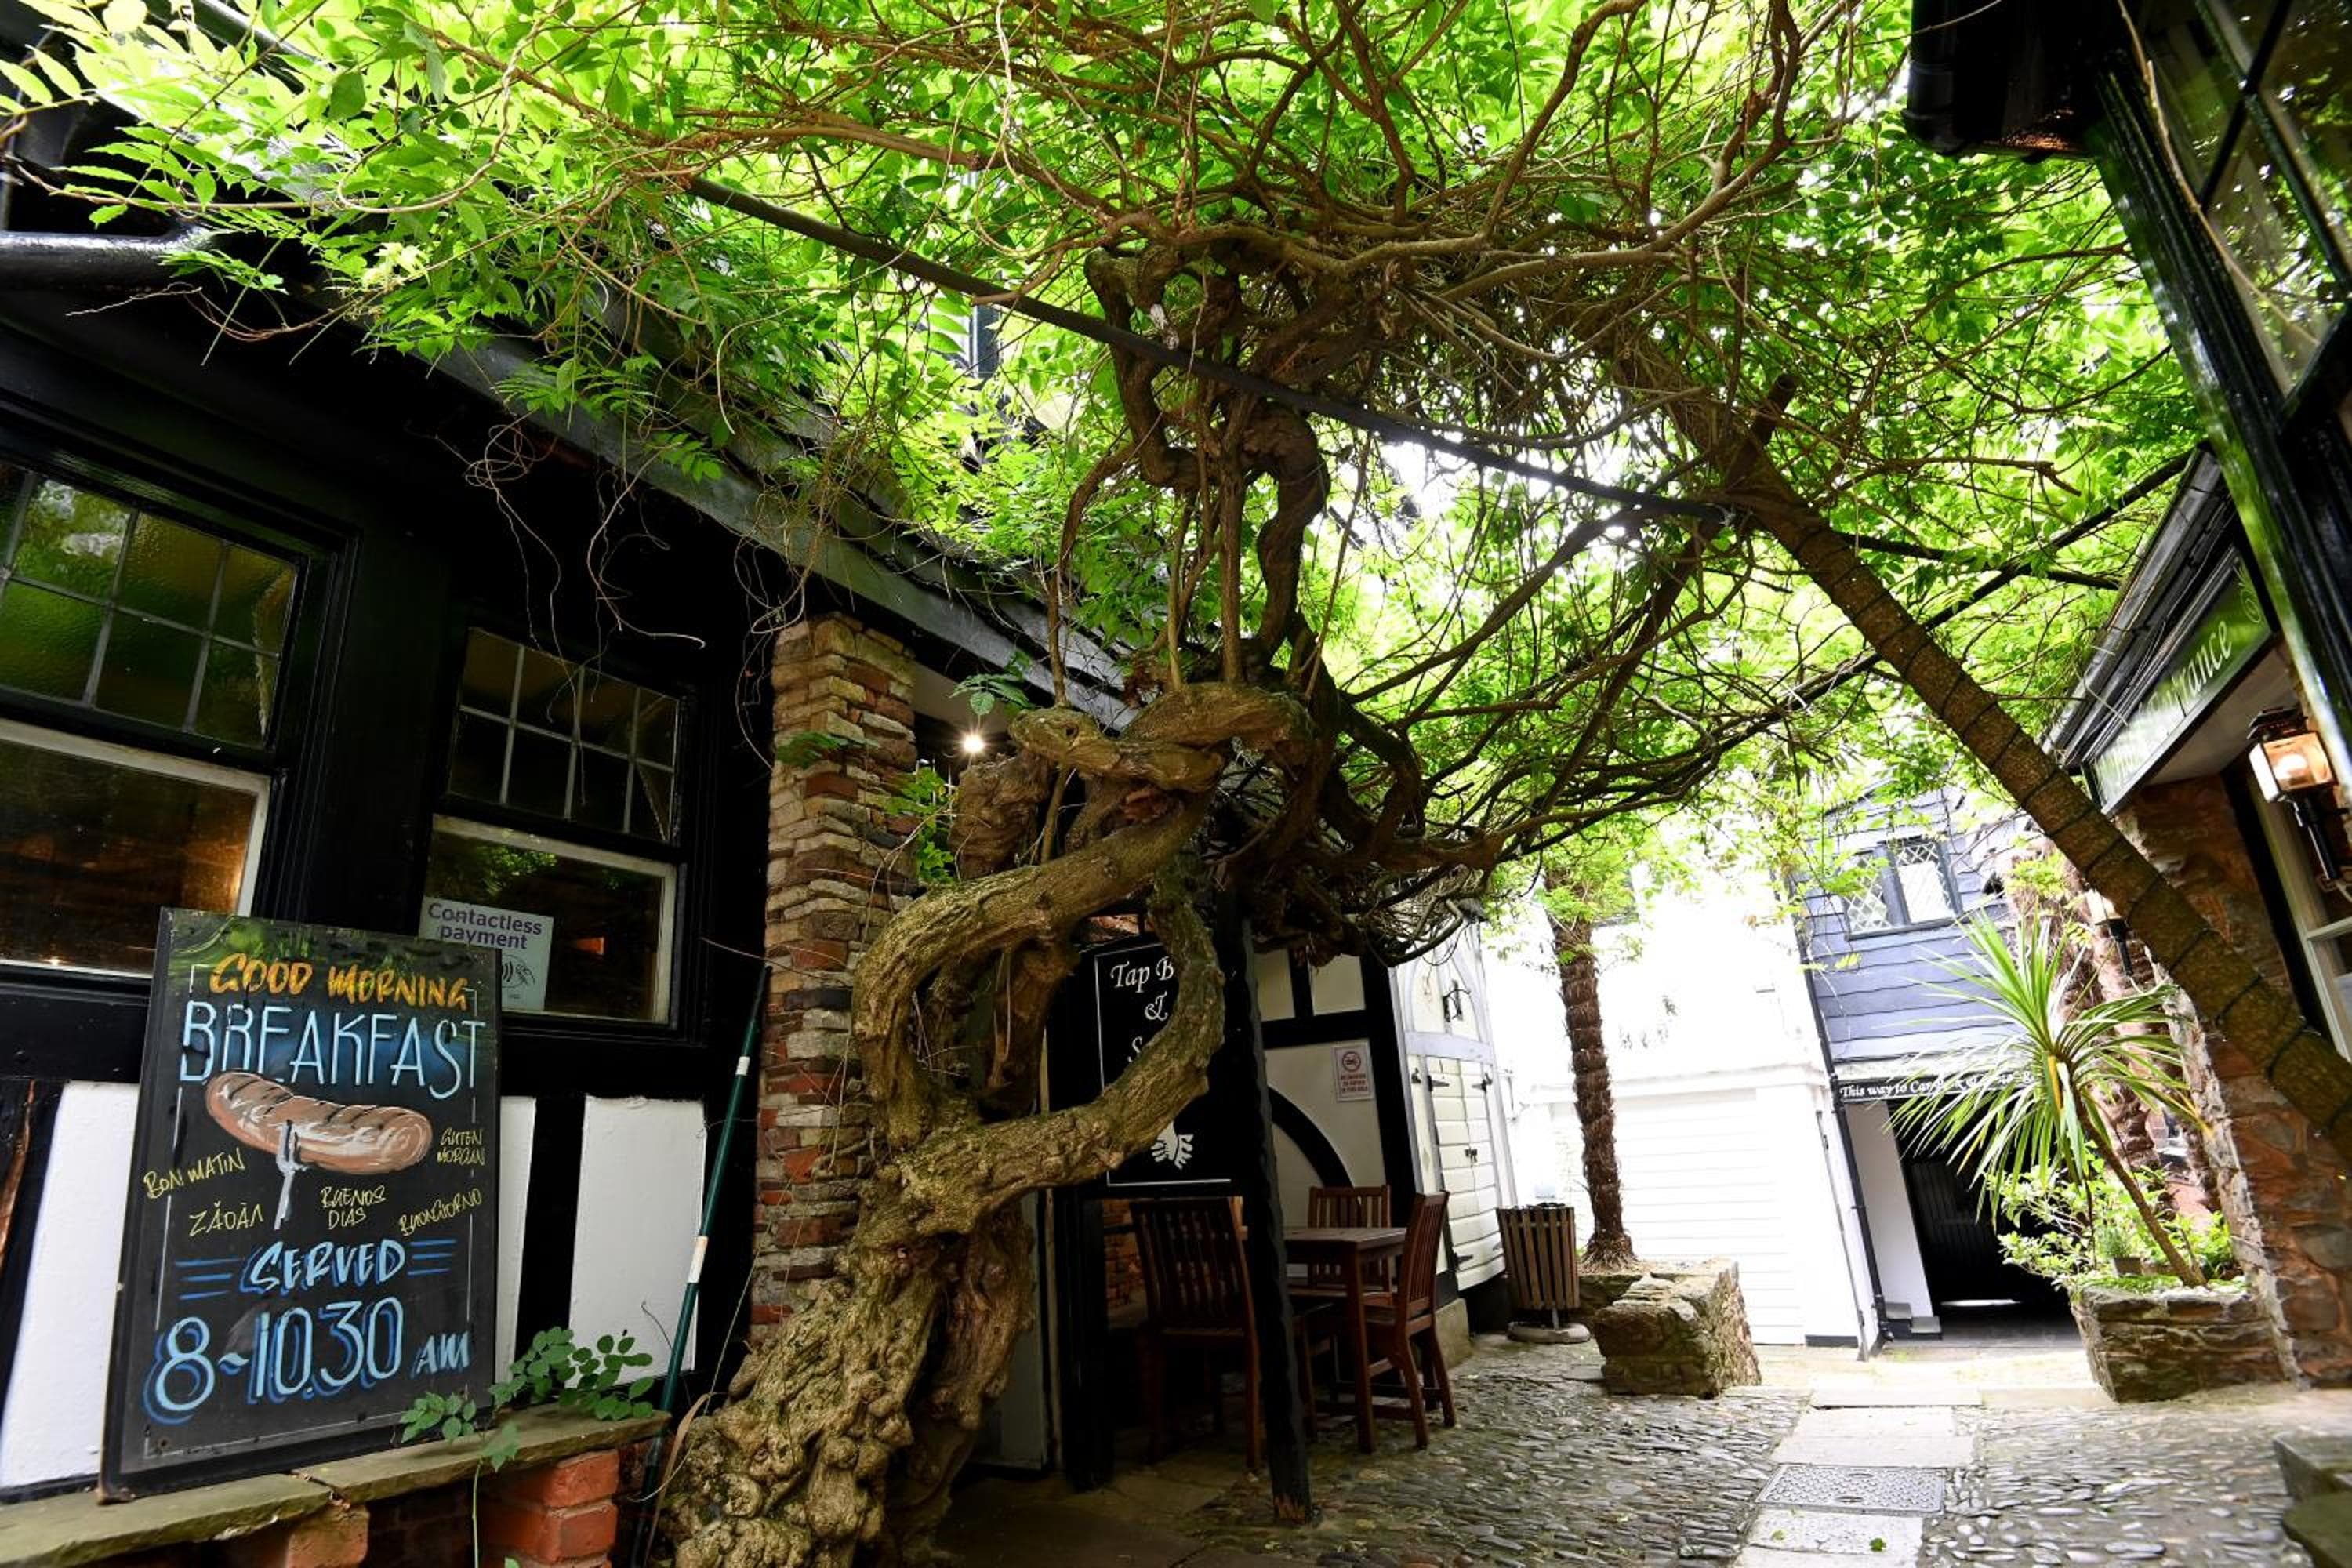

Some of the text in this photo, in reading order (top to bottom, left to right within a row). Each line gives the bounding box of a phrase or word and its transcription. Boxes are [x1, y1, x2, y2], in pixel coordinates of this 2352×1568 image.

[428, 902, 543, 935] Contactless
[440, 925, 528, 949] payment
[210, 953, 468, 1011] GOOD MORNING
[1110, 961, 1150, 993] Tap
[1145, 991, 1169, 1022] &
[180, 1000, 486, 1099] BREAKFAST
[1839, 1084, 1865, 1097] This
[441, 1127, 484, 1146] GUTEN
[143, 1147, 245, 1200] BON MATIN
[320, 1185, 387, 1209] BUENOS
[328, 1207, 366, 1230] DIAS
[245, 1239, 406, 1294] SERVED
[413, 1331, 471, 1377] AM
